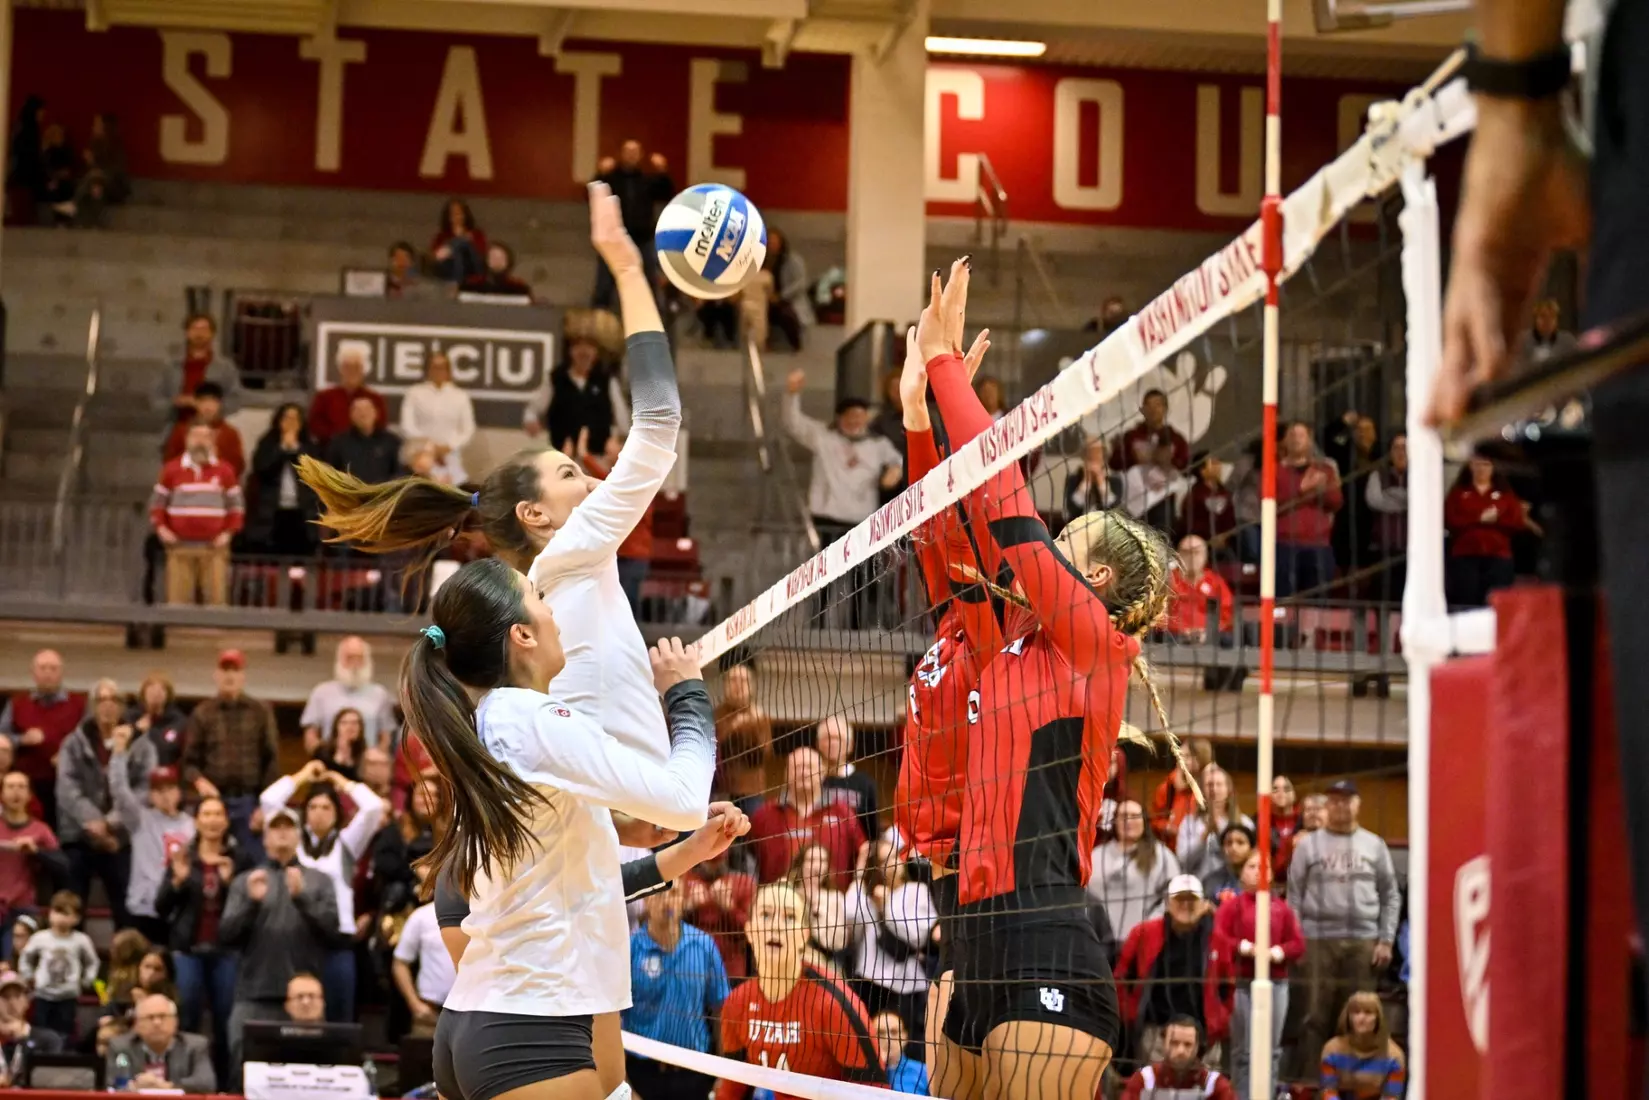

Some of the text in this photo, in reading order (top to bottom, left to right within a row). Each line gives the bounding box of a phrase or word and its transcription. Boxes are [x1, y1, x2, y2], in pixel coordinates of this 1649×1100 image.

[157, 31, 747, 190] STATE
[694, 199, 726, 257] molten
[747, 1018, 802, 1045] UTAH
